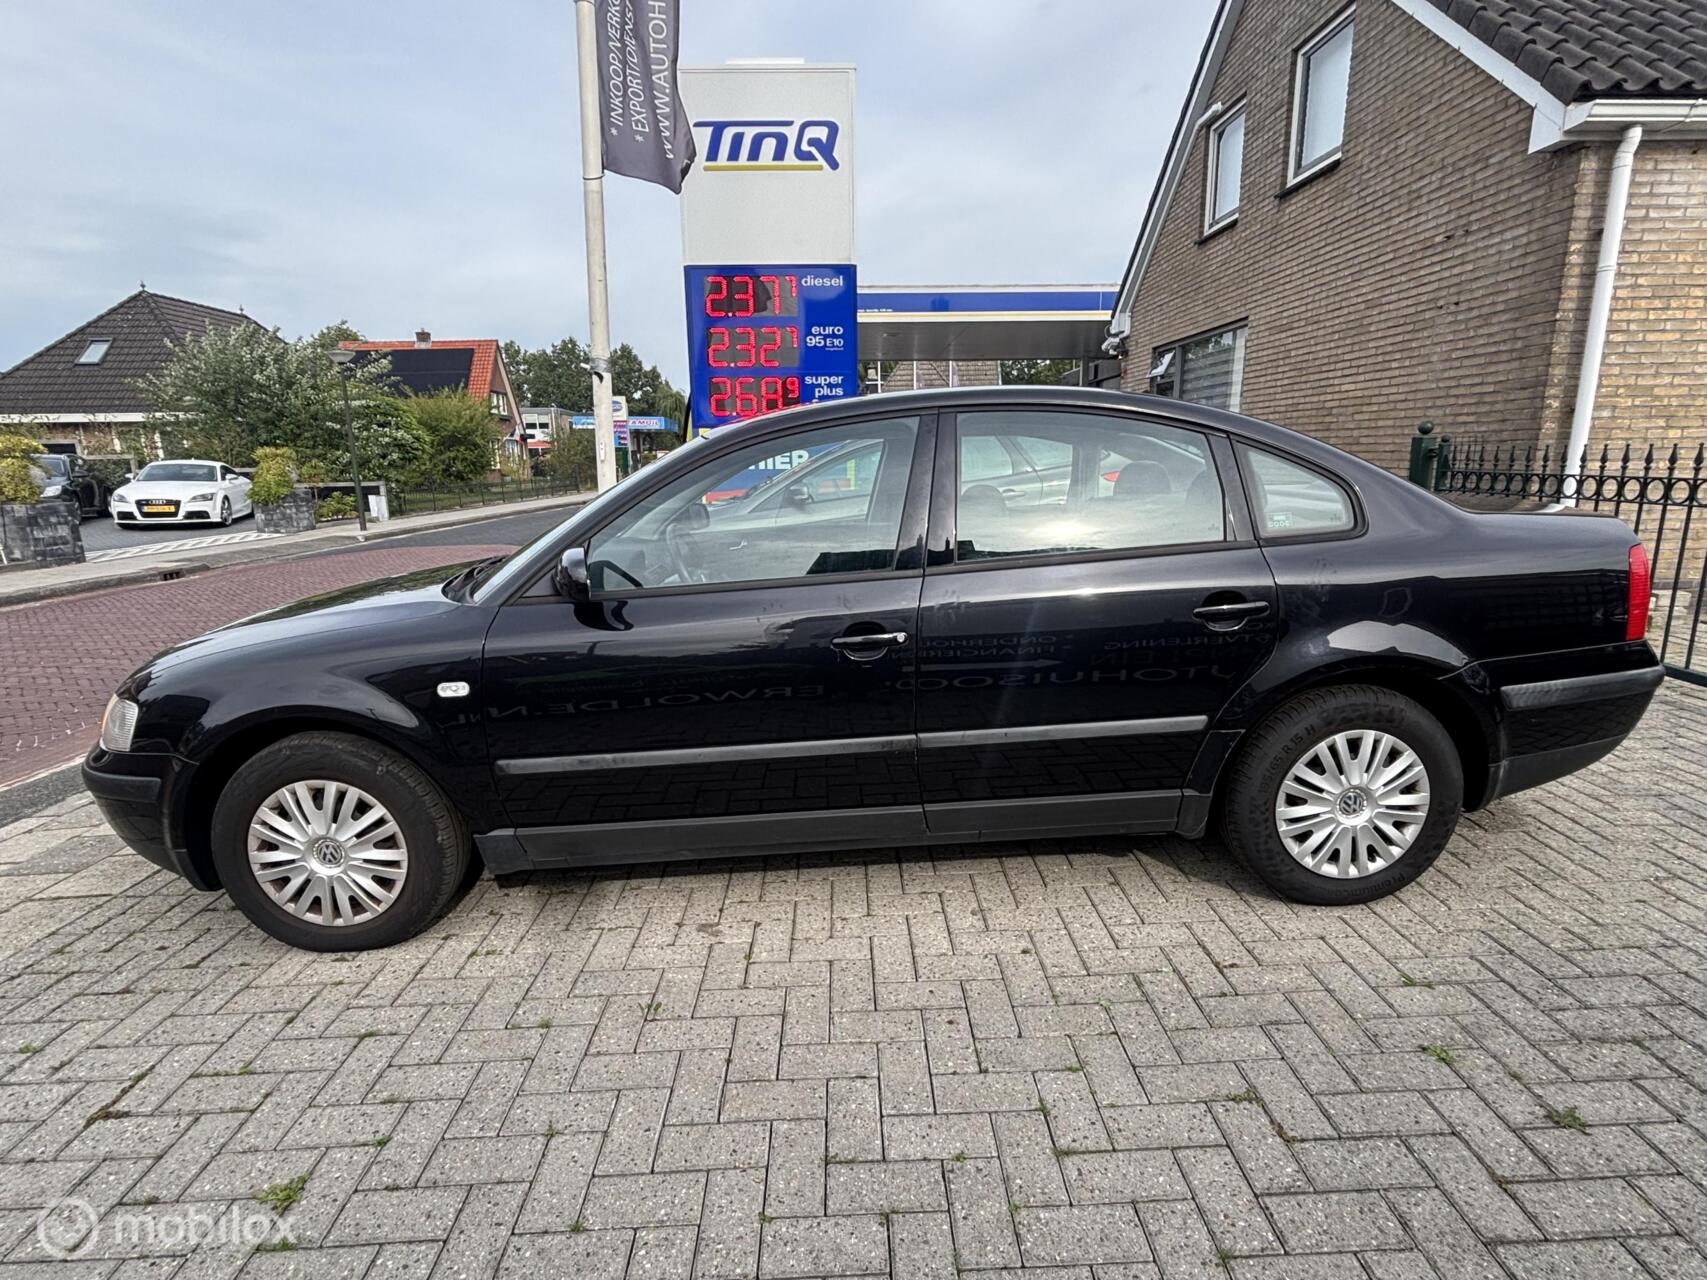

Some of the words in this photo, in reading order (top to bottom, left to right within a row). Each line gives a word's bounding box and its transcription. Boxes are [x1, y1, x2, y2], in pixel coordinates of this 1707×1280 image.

[606, 0, 624, 126] INKOOP/VERK
[801, 275, 843, 287] diesel
[811, 326, 843, 335] euro
[805, 336, 824, 347] 95
[826, 338, 844, 347] E10
[804, 374, 844, 385] super
[815, 385, 844, 402] plus
